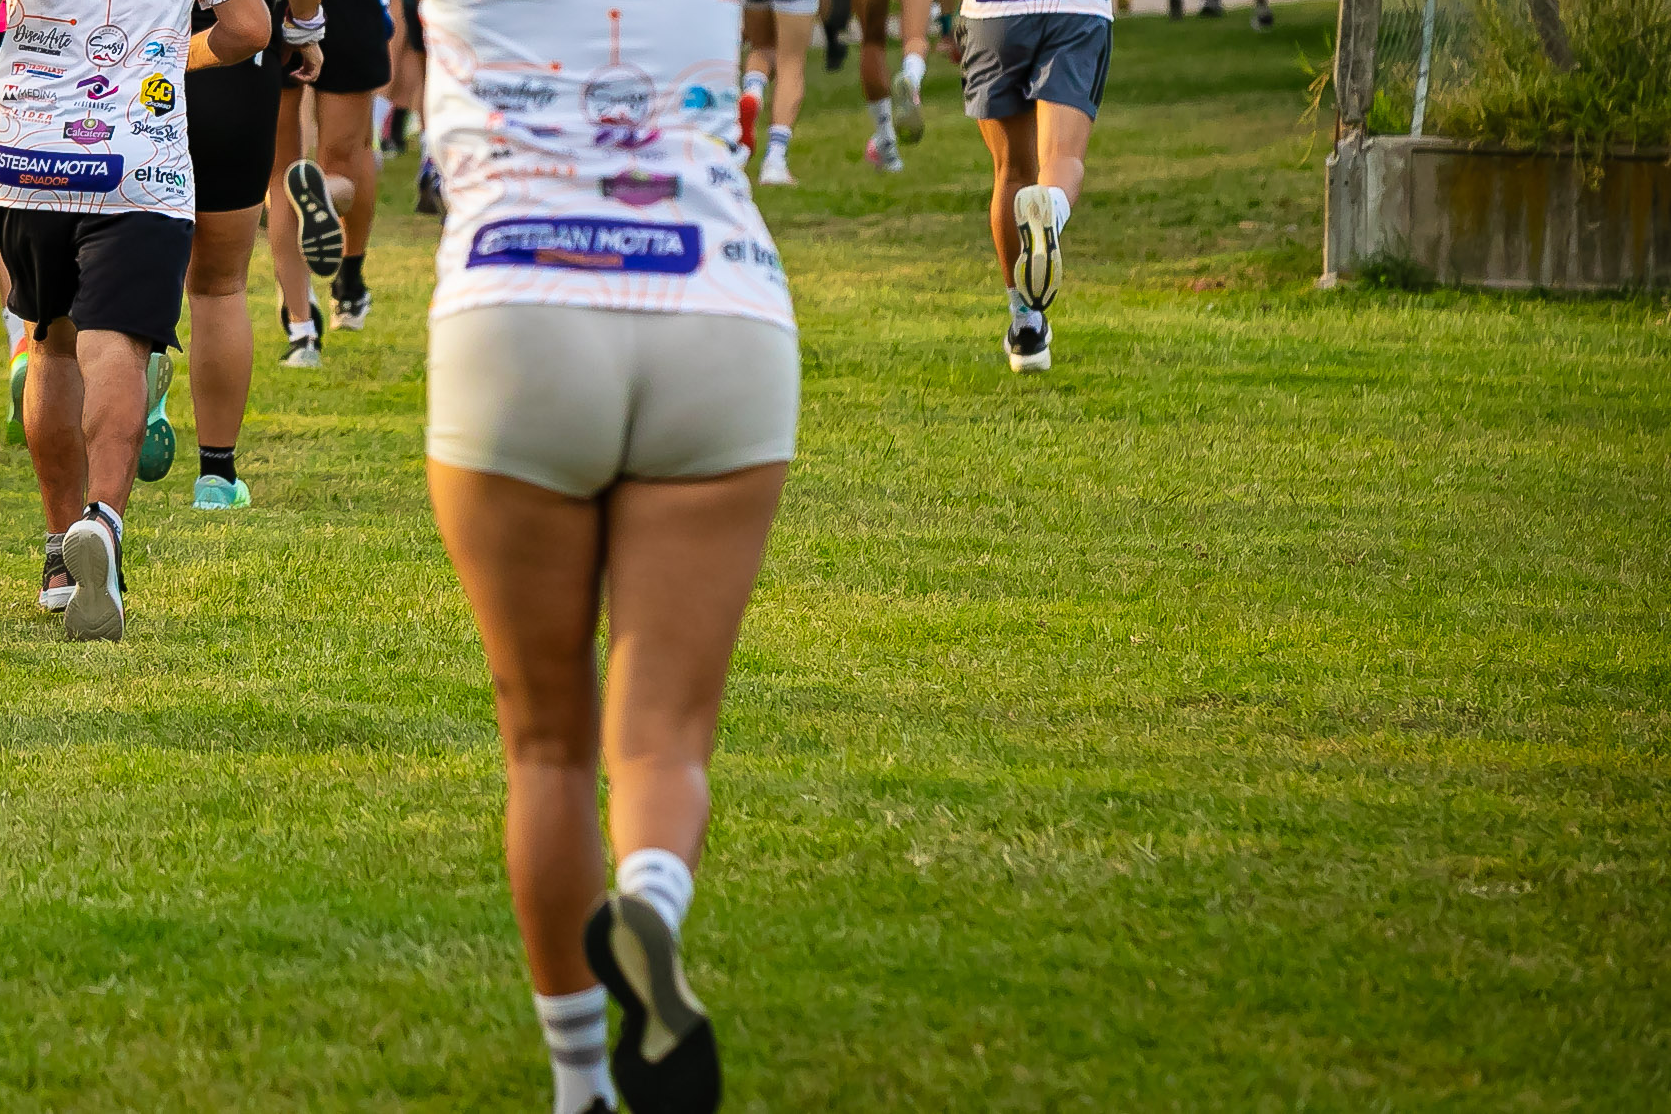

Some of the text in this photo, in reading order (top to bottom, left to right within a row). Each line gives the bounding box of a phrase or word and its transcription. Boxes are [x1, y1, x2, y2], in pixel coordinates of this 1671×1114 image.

[18, 88, 58, 102] MEDINA
[65, 127, 111, 138] Calcaterra
[53, 159, 109, 176] MOTTA
[134, 165, 152, 182] el
[19, 174, 69, 186] SENADOR
